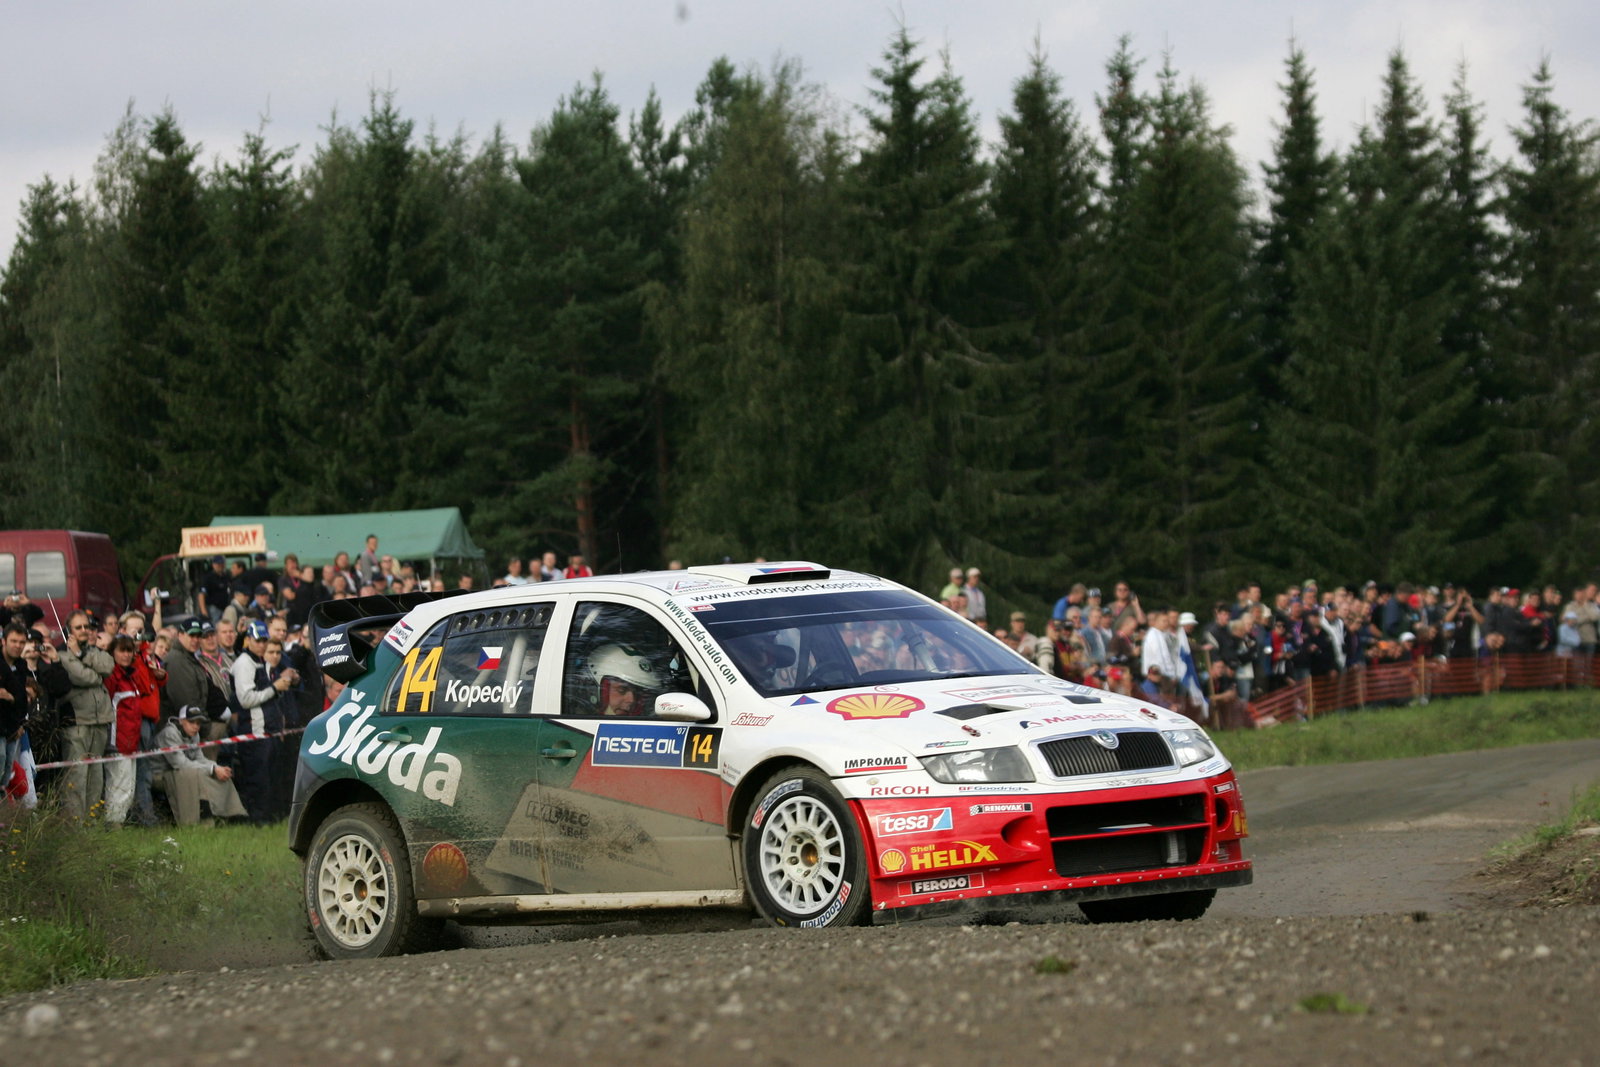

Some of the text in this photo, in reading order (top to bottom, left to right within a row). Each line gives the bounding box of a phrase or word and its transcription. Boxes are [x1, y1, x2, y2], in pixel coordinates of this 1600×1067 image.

[664, 599, 738, 686] www.skoda-auto.com
[397, 646, 443, 712] 14
[444, 680, 523, 707] Kopecký
[308, 688, 463, 807] Škoda
[598, 737, 680, 754] NESTE OIL
[691, 734, 713, 763] 14
[844, 756, 908, 769] IMPROMAT
[871, 785, 930, 796] RICOH
[910, 844, 935, 853] Shell
[911, 840, 998, 871] HELIX
[914, 877, 967, 893] FERODO
